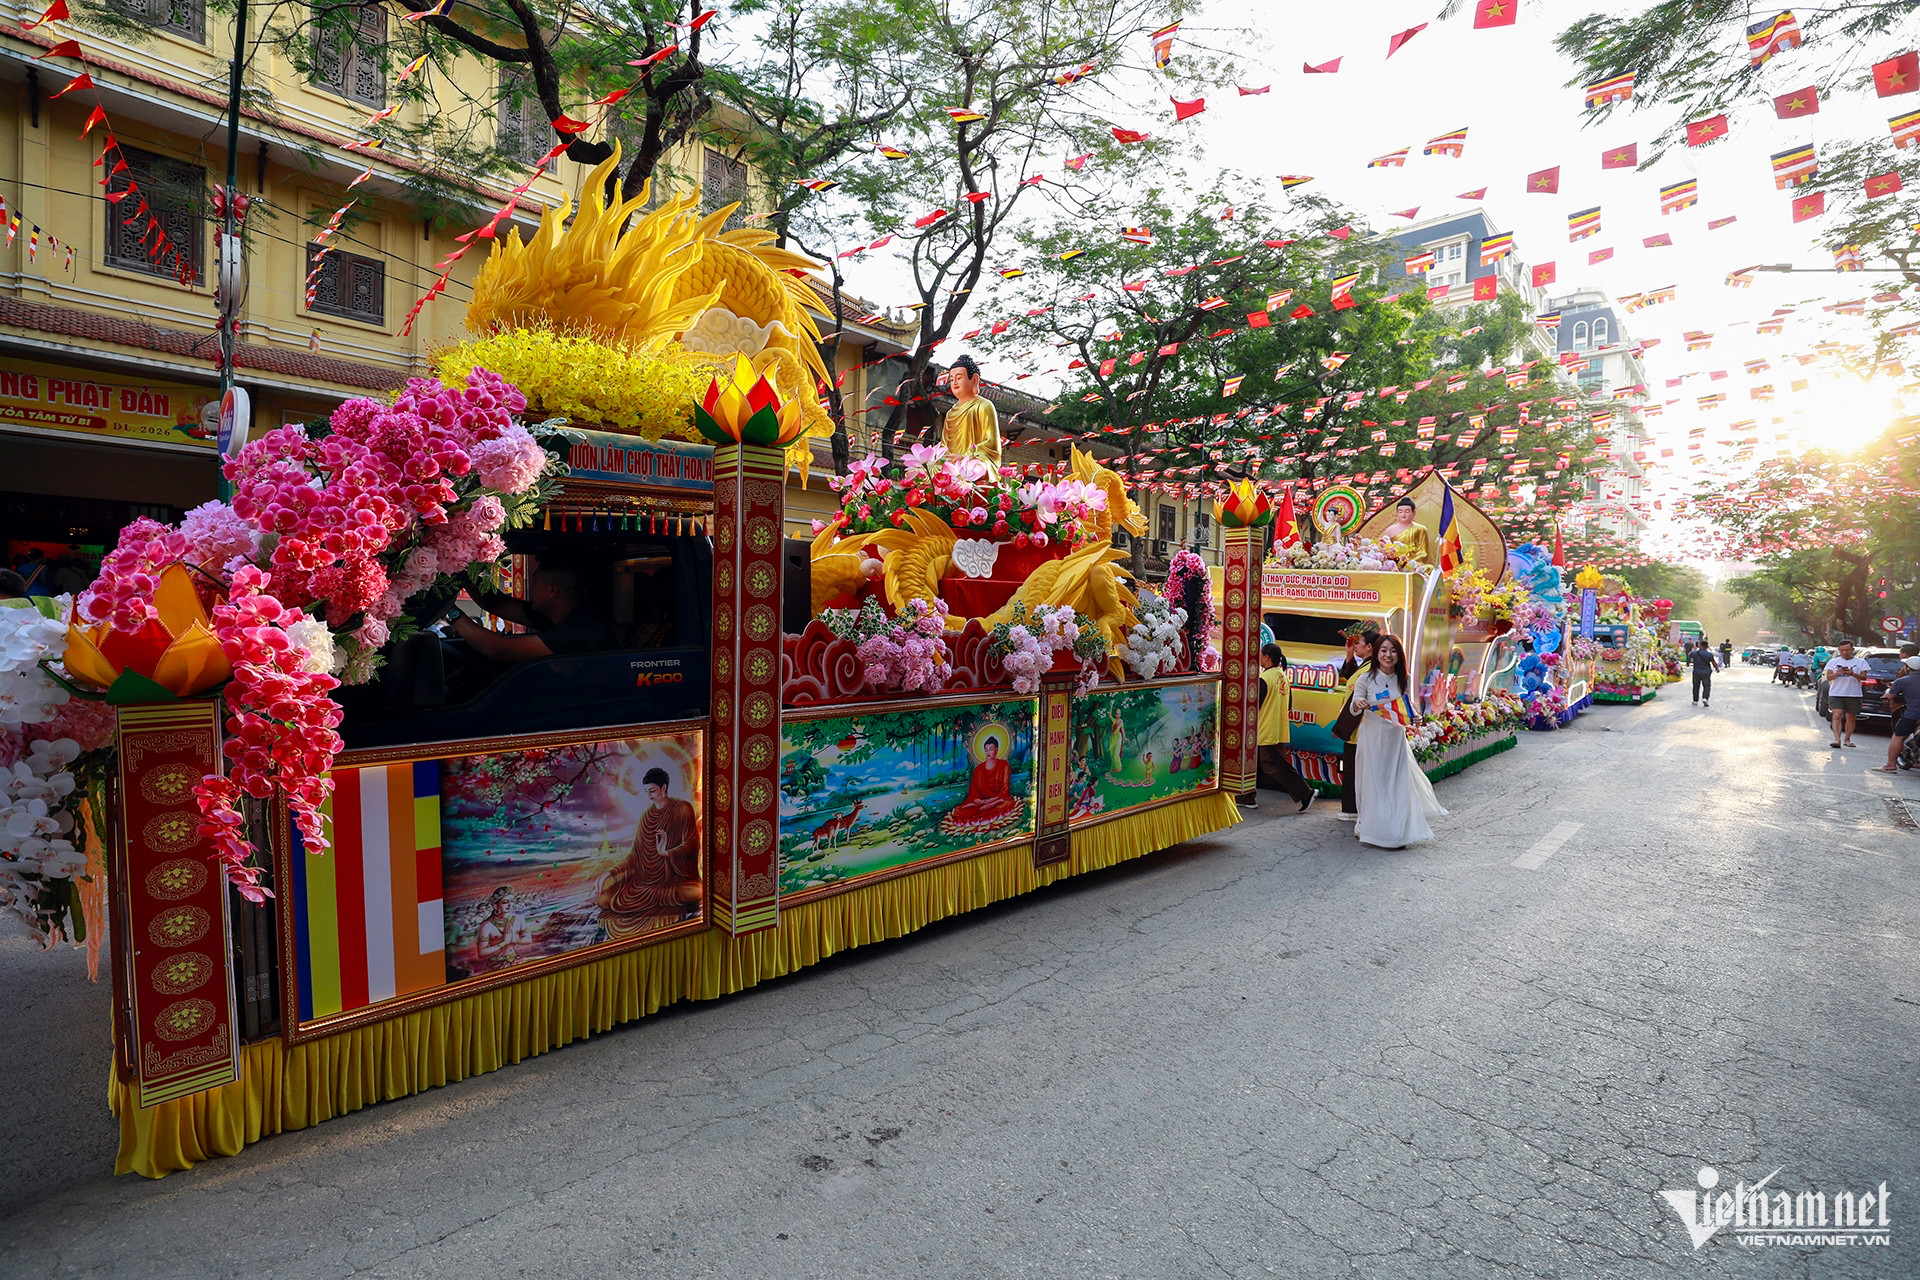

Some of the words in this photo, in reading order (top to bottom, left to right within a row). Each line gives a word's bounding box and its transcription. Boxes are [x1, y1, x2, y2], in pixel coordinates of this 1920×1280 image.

[47, 378, 113, 414] PHẬT
[119, 385, 170, 418] ĐẢN
[28, 411, 56, 422] TÂM
[60, 414, 77, 424] TỪ
[78, 418, 91, 426] BI
[140, 425, 170, 436] 2026
[600, 442, 625, 474] LÂM
[626, 449, 654, 481] CHỢT
[656, 447, 681, 479] THẤY
[683, 456, 703, 481] HOA
[1266, 573, 1284, 585] THAY
[1285, 572, 1300, 585] ĐỨC
[1301, 573, 1321, 587] PHẬT
[1322, 575, 1333, 586] RA
[1271, 584, 1285, 597] THẾ
[1286, 586, 1306, 599] RẠNG
[1346, 590, 1378, 602] THƯƠNG
[630, 659, 681, 669] FRONTIER
[636, 672, 683, 687] K200
[1296, 665, 1316, 686] TÂY
